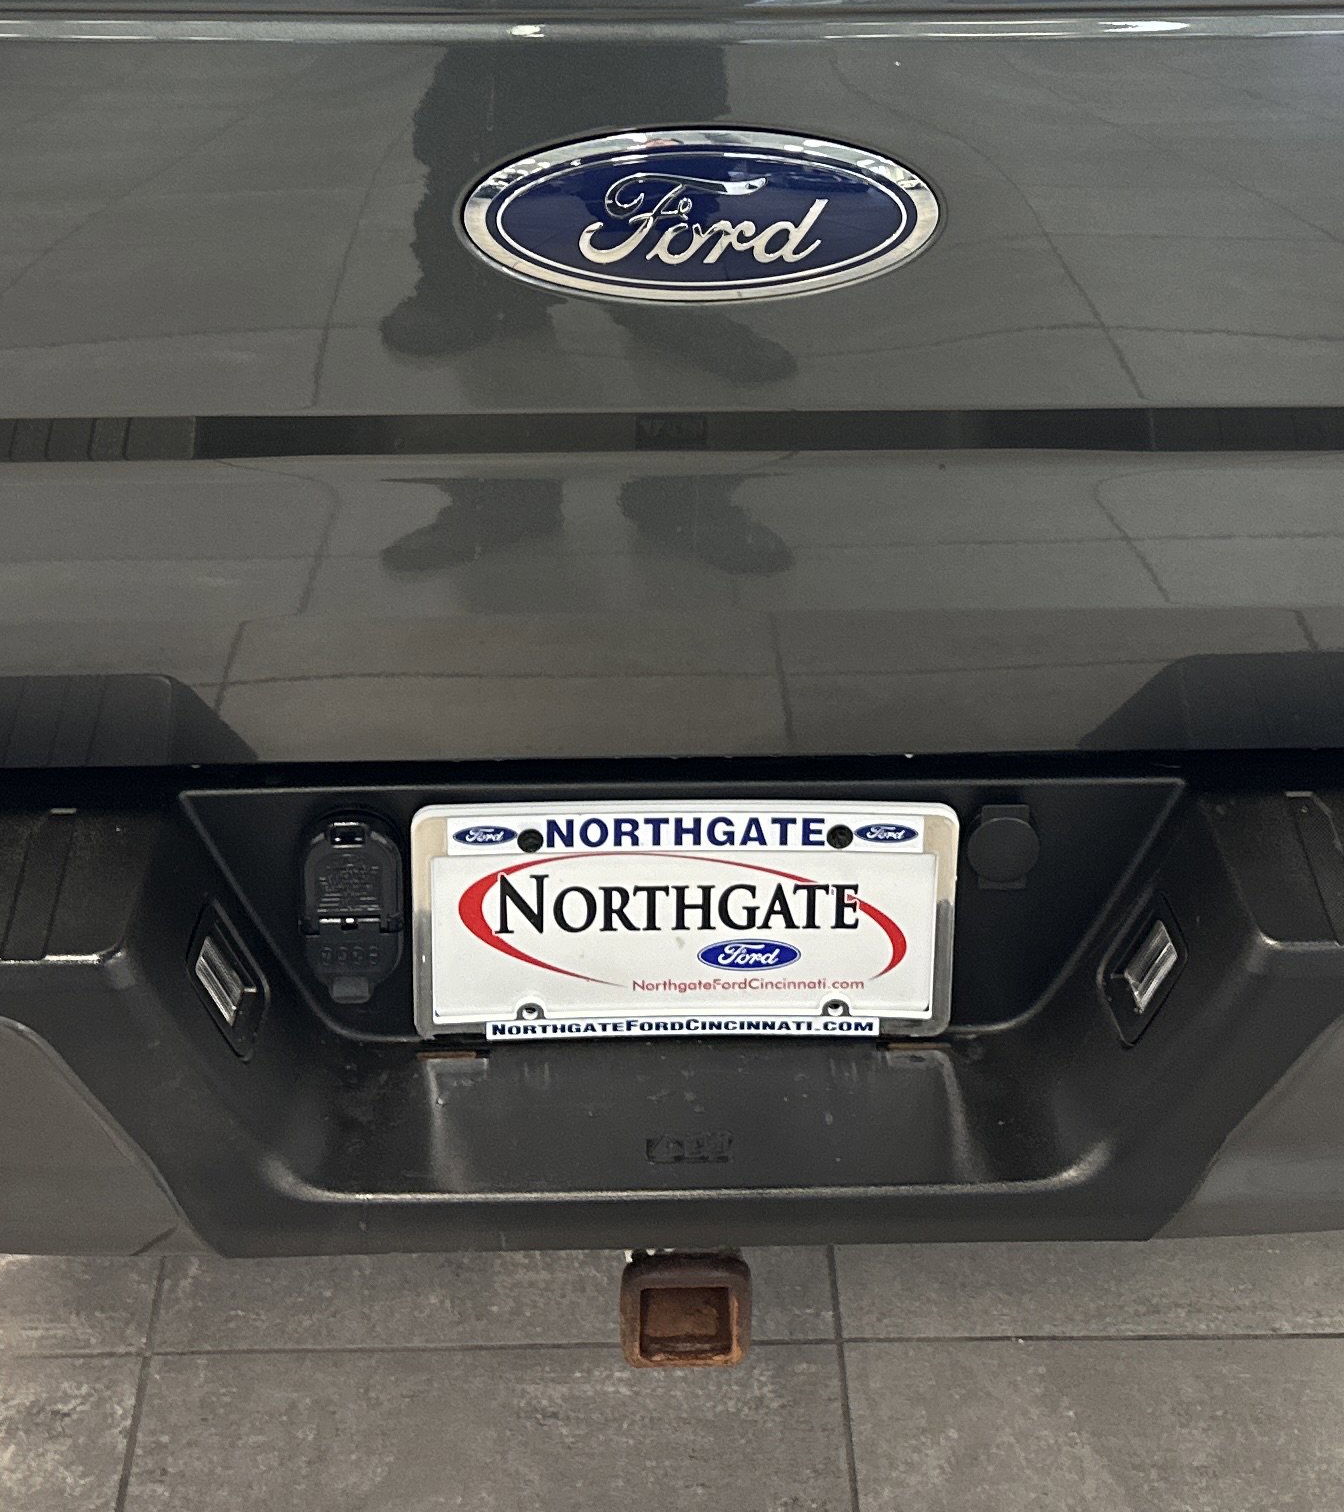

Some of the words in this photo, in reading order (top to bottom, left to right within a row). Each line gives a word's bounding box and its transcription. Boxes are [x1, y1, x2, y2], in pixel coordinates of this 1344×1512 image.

[578, 172, 829, 265] Ford
[545, 817, 825, 847] NORTHGATE
[494, 873, 860, 934] NORTHGATE
[632, 978, 865, 993] NorthgateFordCincinnati.com
